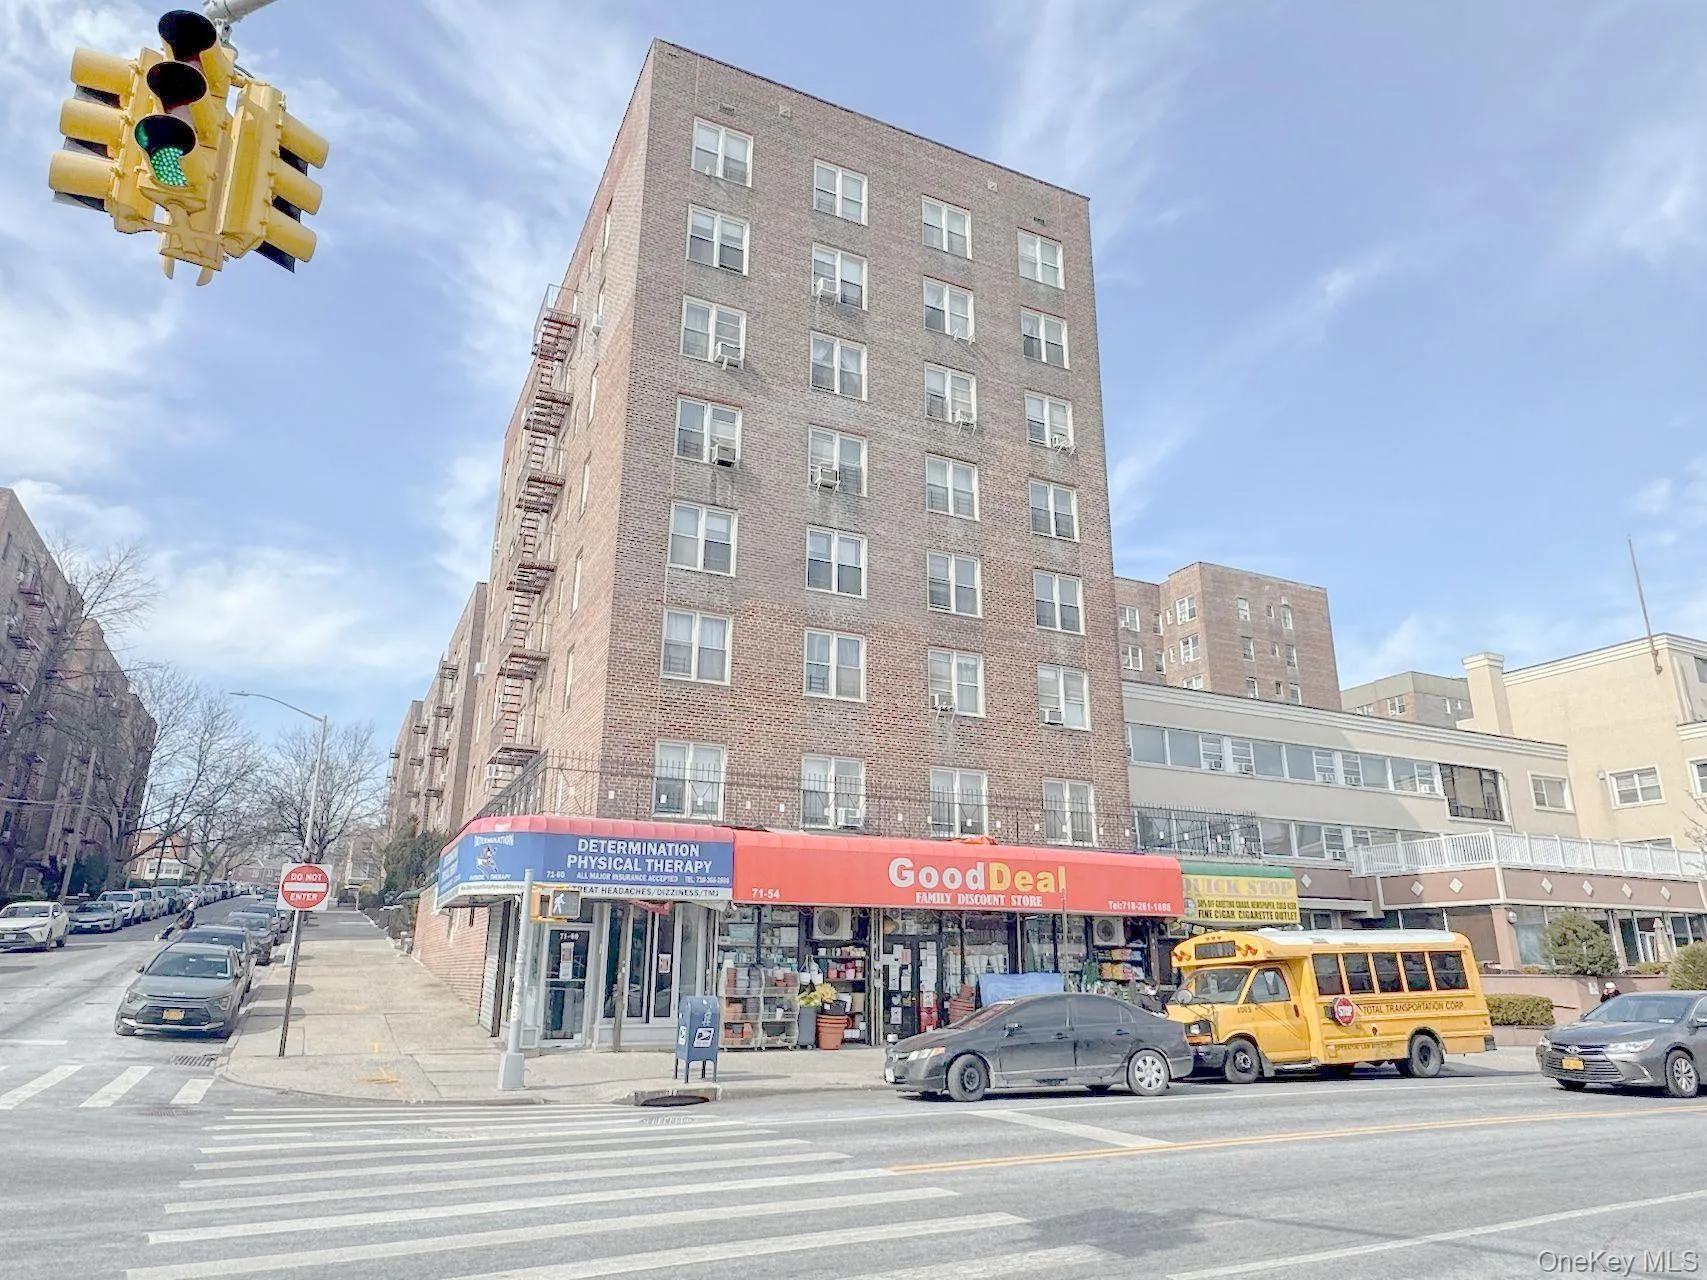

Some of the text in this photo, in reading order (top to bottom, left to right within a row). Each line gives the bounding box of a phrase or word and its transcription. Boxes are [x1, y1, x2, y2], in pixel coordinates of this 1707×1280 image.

[578, 839, 700, 857] DETERMINATION
[567, 854, 713, 874] PHYSICAL THERAPY
[305, 873, 322, 881] NOT
[589, 872, 611, 880] MAJOR
[611, 873, 648, 882] INSURANCE
[648, 874, 679, 883] ACCEPTED
[888, 857, 1066, 894] GoodDeal
[752, 888, 780, 899] 71-54
[1247, 879, 1292, 896] STOP
[915, 892, 1043, 907] FAMILY DISCOUNT STORE
[1198, 909, 1298, 920] FINE CIGAR CIGARETTE OUTLET
[1338, 1005, 1353, 1016] STOP
[1363, 1005, 1384, 1014] TOTAL
[1386, 1002, 1444, 1013] TRANSPORTATION
